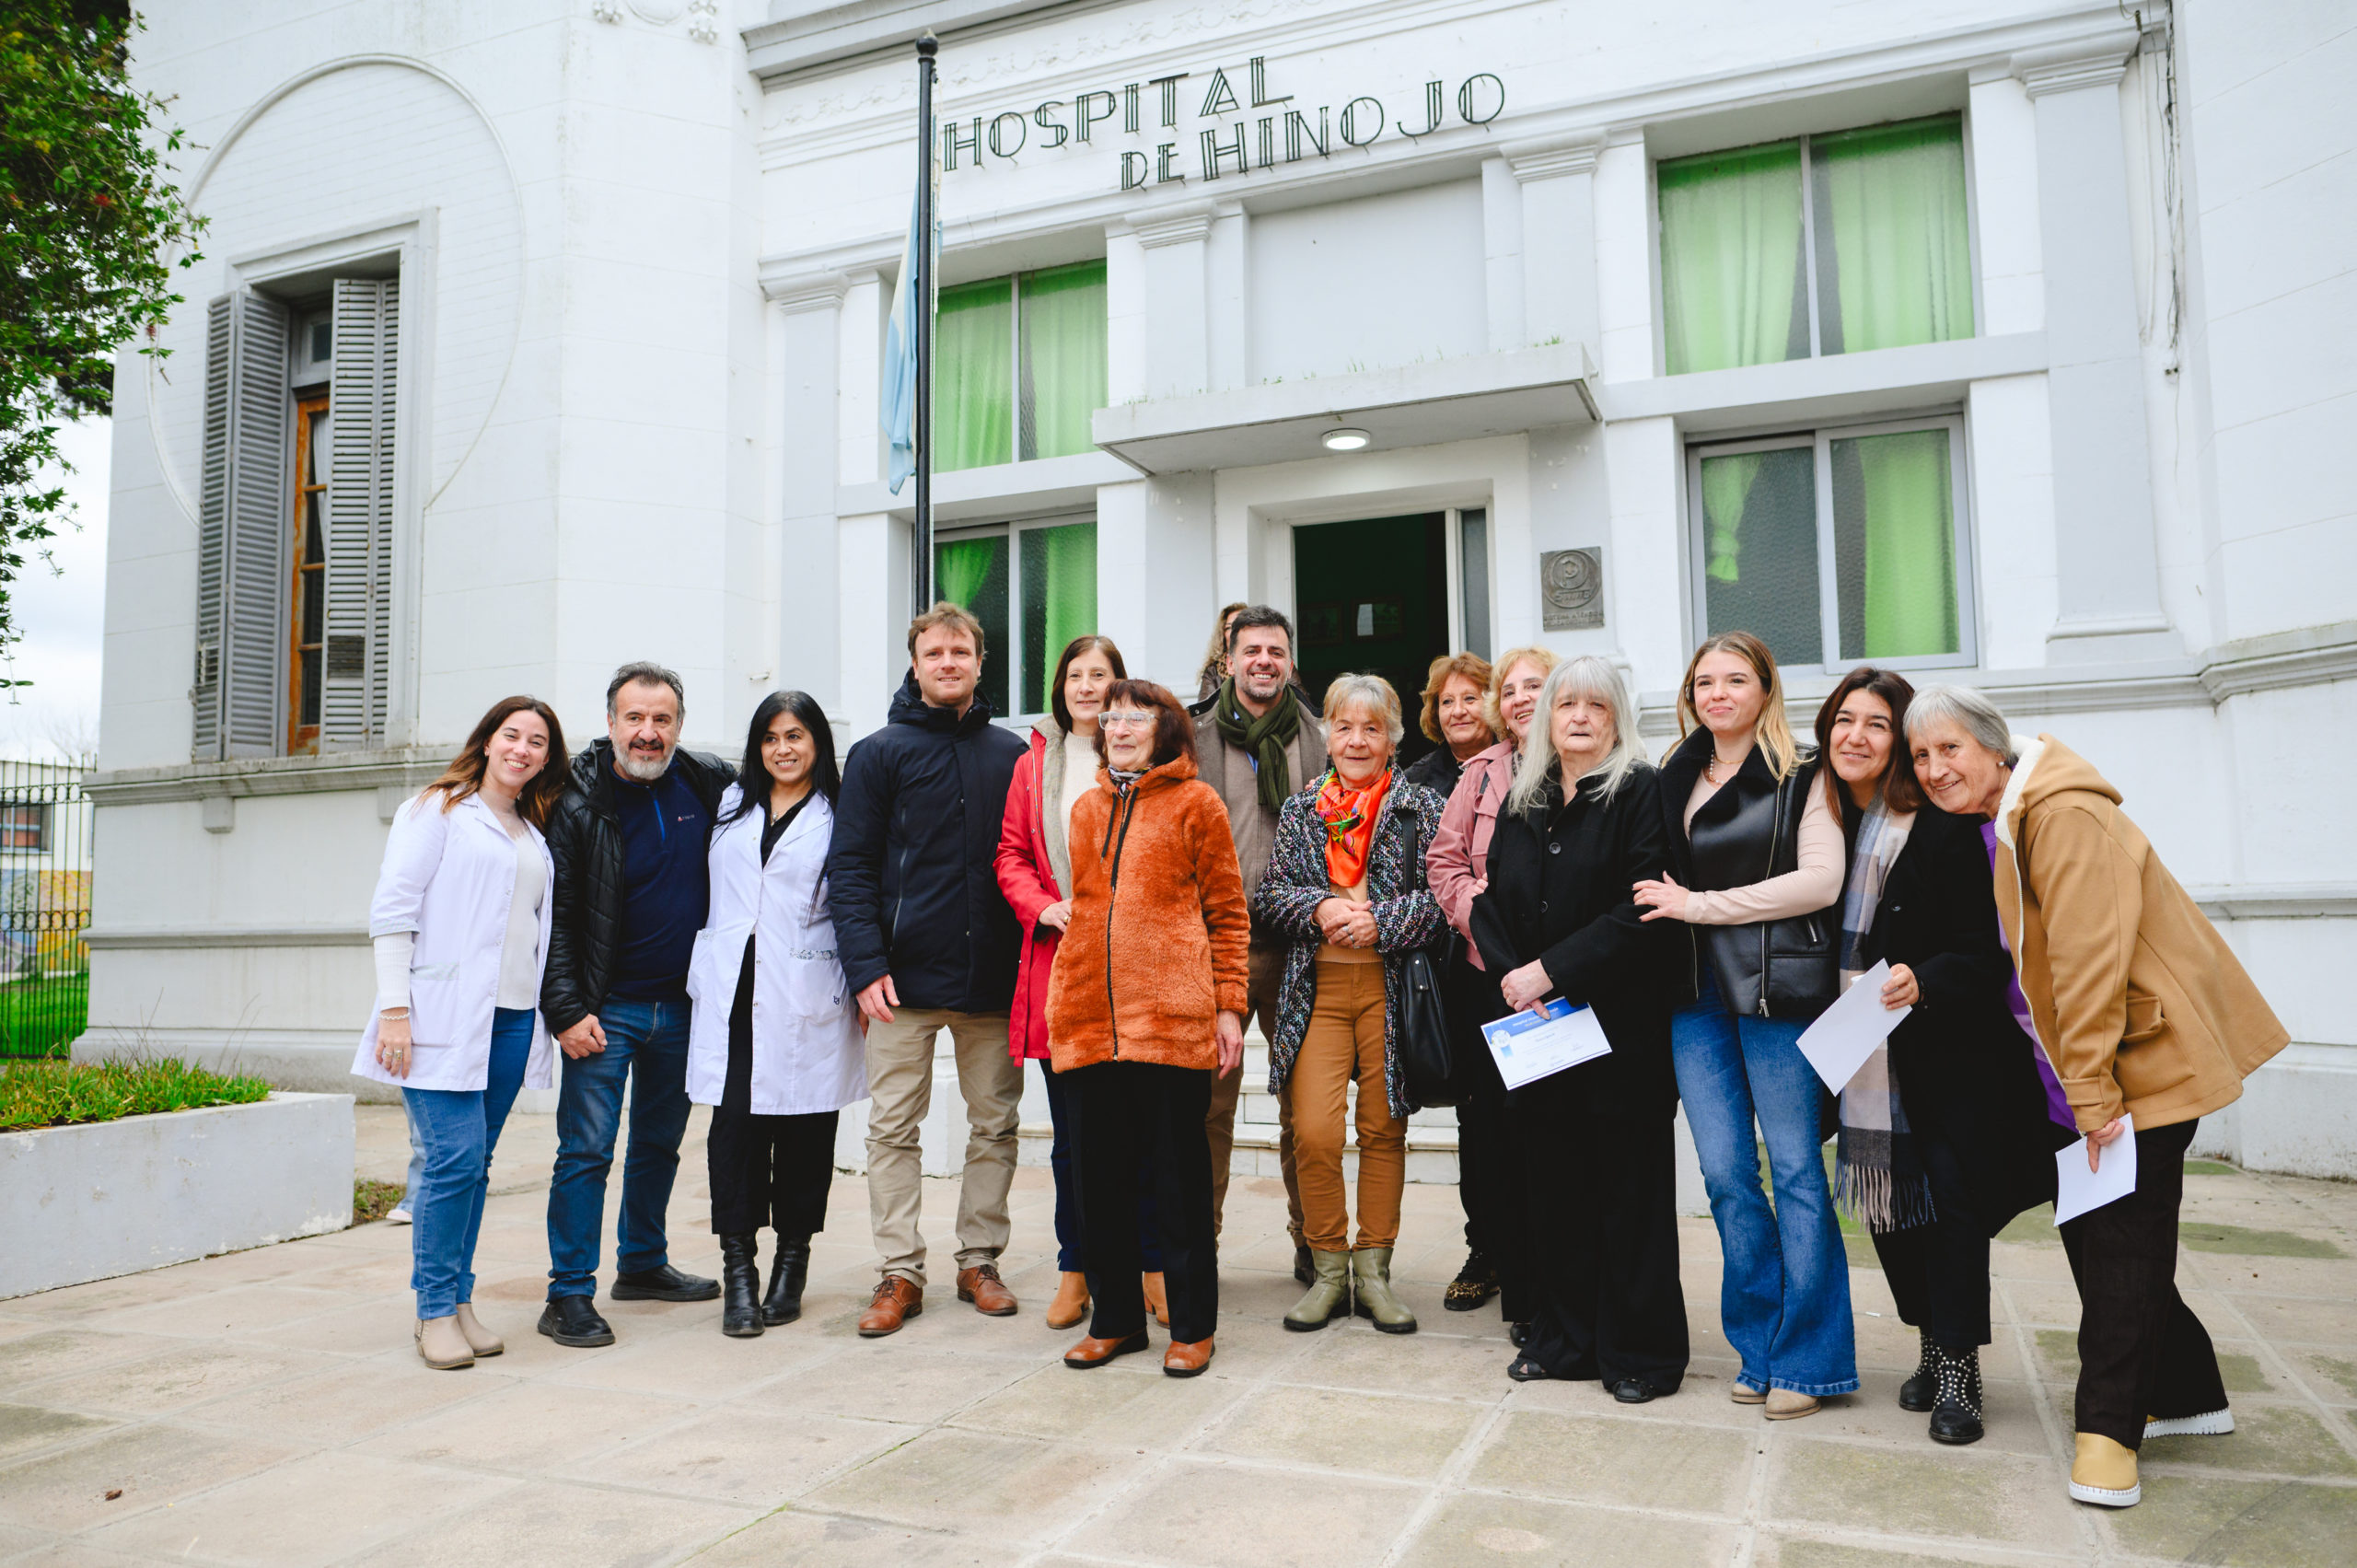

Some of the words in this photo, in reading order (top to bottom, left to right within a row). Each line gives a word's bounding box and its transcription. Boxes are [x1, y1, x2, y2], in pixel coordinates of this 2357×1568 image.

[944, 55, 1295, 172] HOSPITAL
[1120, 142, 1186, 191] DE
[1199, 73, 1505, 182] HINOJO
